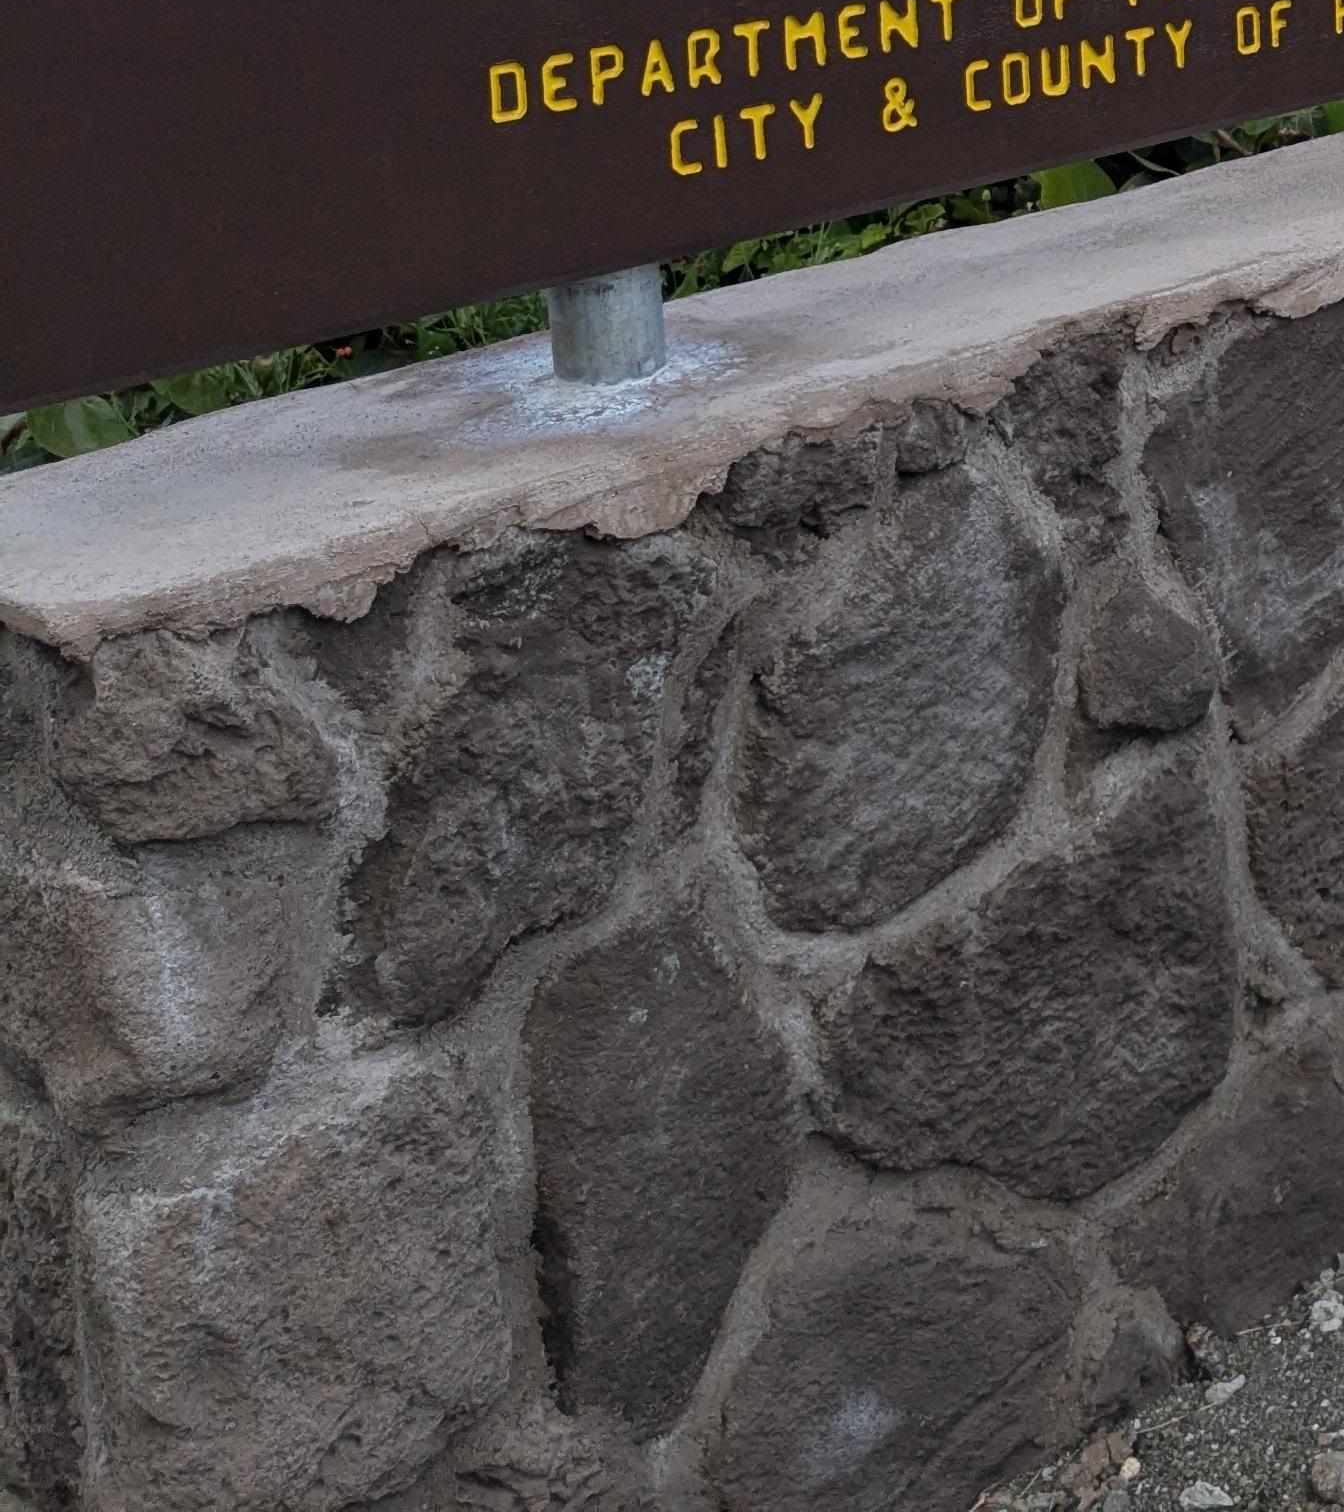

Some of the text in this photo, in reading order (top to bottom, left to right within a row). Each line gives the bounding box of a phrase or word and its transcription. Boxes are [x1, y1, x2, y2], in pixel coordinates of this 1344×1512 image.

[669, 93, 823, 176] CITY
[882, 77, 919, 133] &
[964, 19, 1193, 112] COUNTY
[1236, 0, 1292, 55] OF
